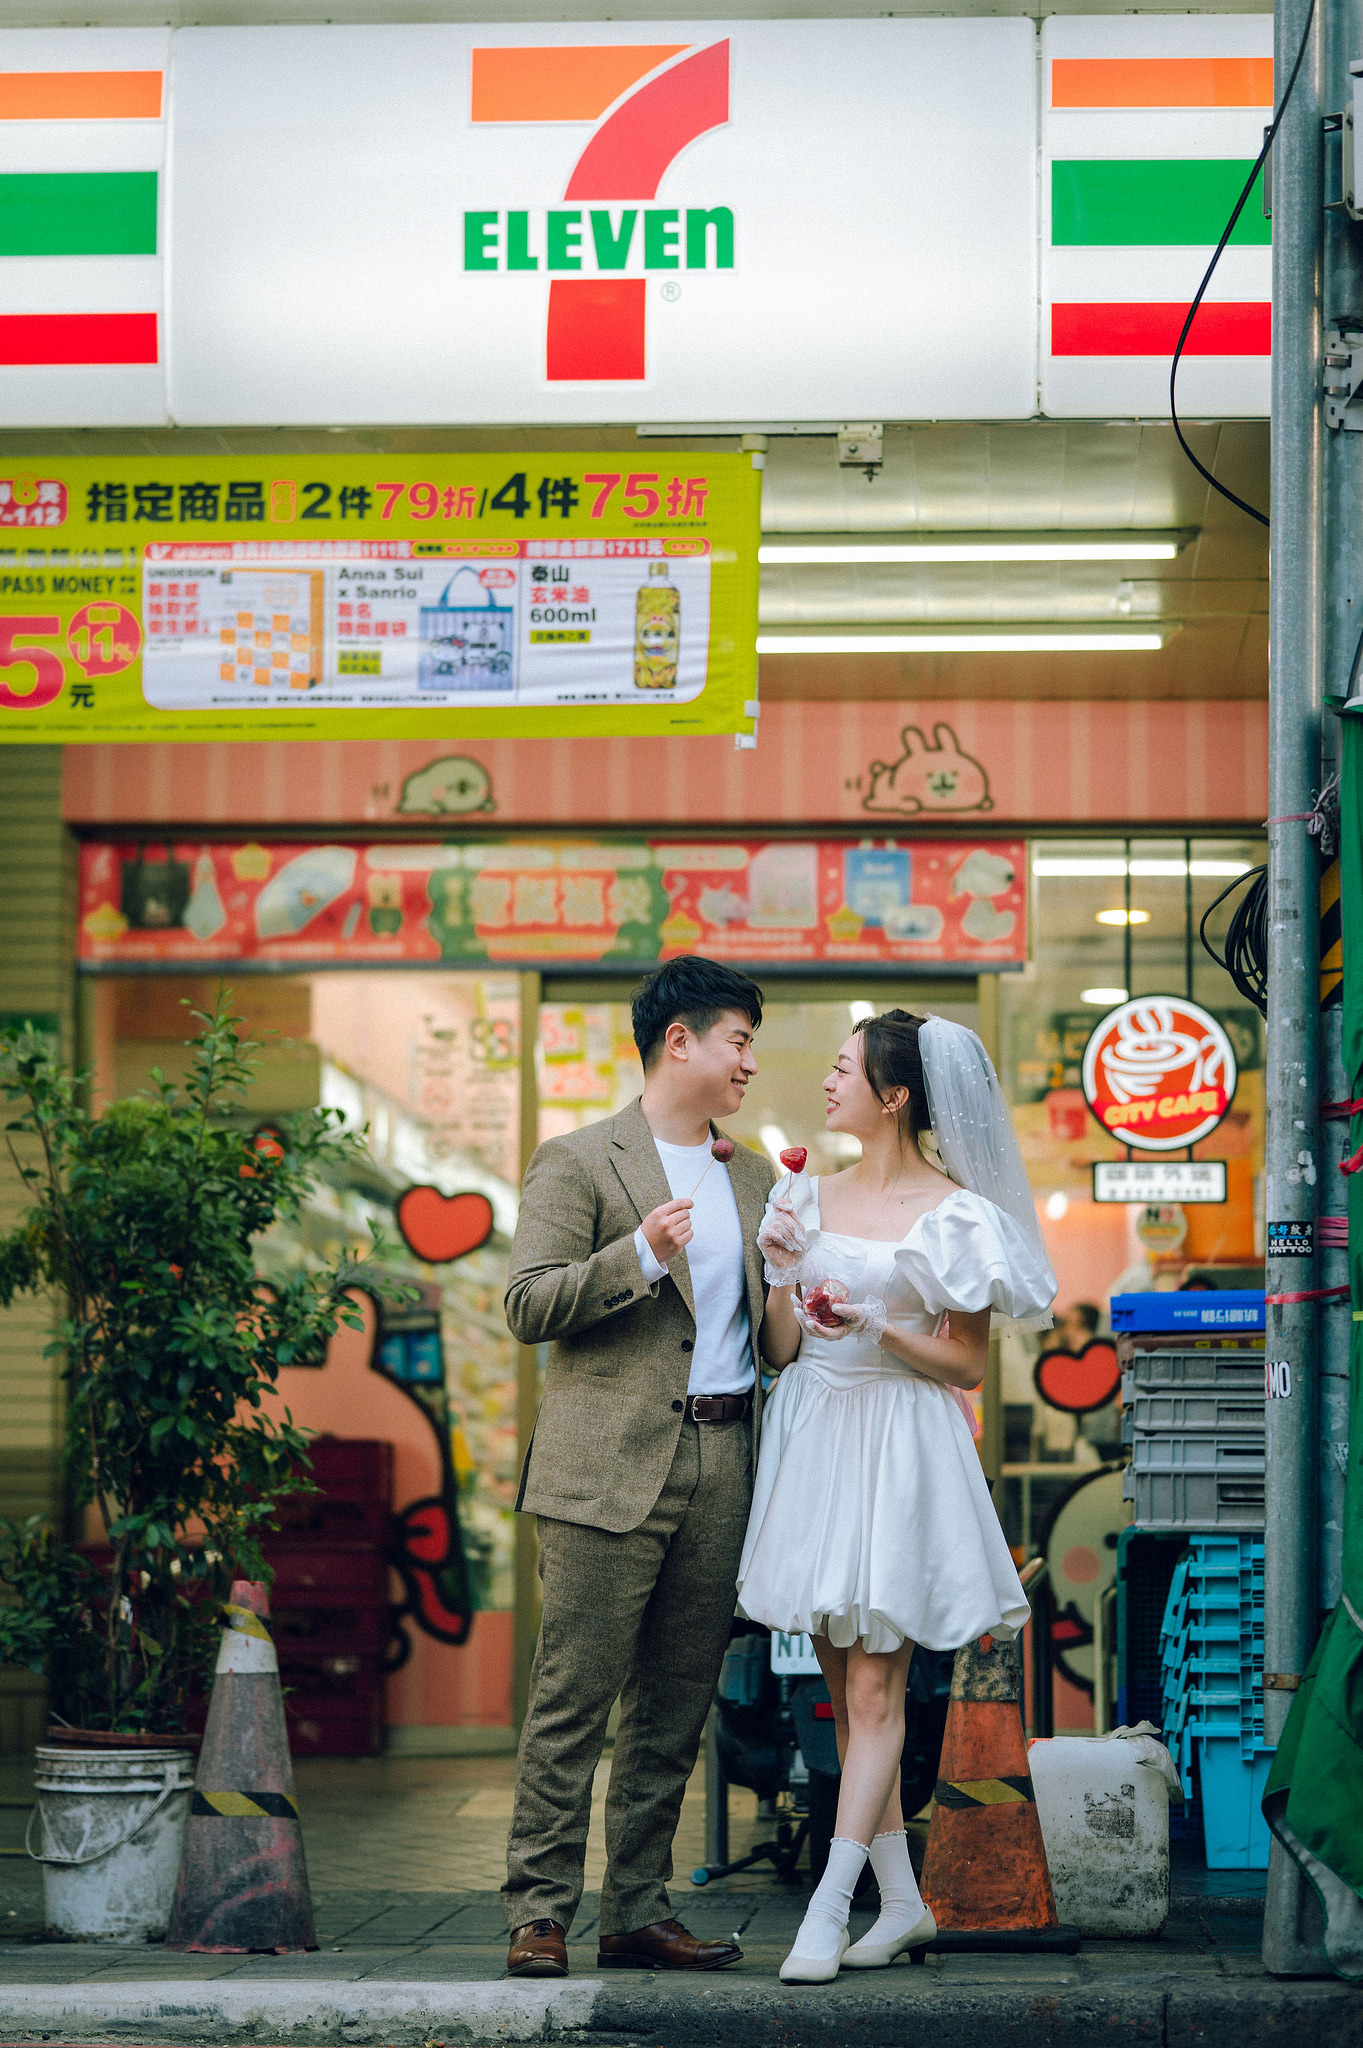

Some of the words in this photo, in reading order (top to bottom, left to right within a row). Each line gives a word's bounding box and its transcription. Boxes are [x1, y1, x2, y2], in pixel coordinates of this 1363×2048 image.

[470, 37, 730, 381] 7
[86, 481, 265, 523] 指定商品
[338, 567, 386, 581] Anna
[394, 567, 424, 581] Sui
[52, 576, 115, 594] MONEY
[356, 585, 418, 599] Sanrio
[531, 586, 590, 604] 玄米油
[530, 608, 597, 623] 600ml
[70, 684, 95, 708] 元
[1103, 1100, 1156, 1127] CITY
[1159, 1091, 1218, 1118] CAFE
[1268, 1246, 1313, 1254] TATTOO
[1270, 1239, 1310, 1247] HELLO
